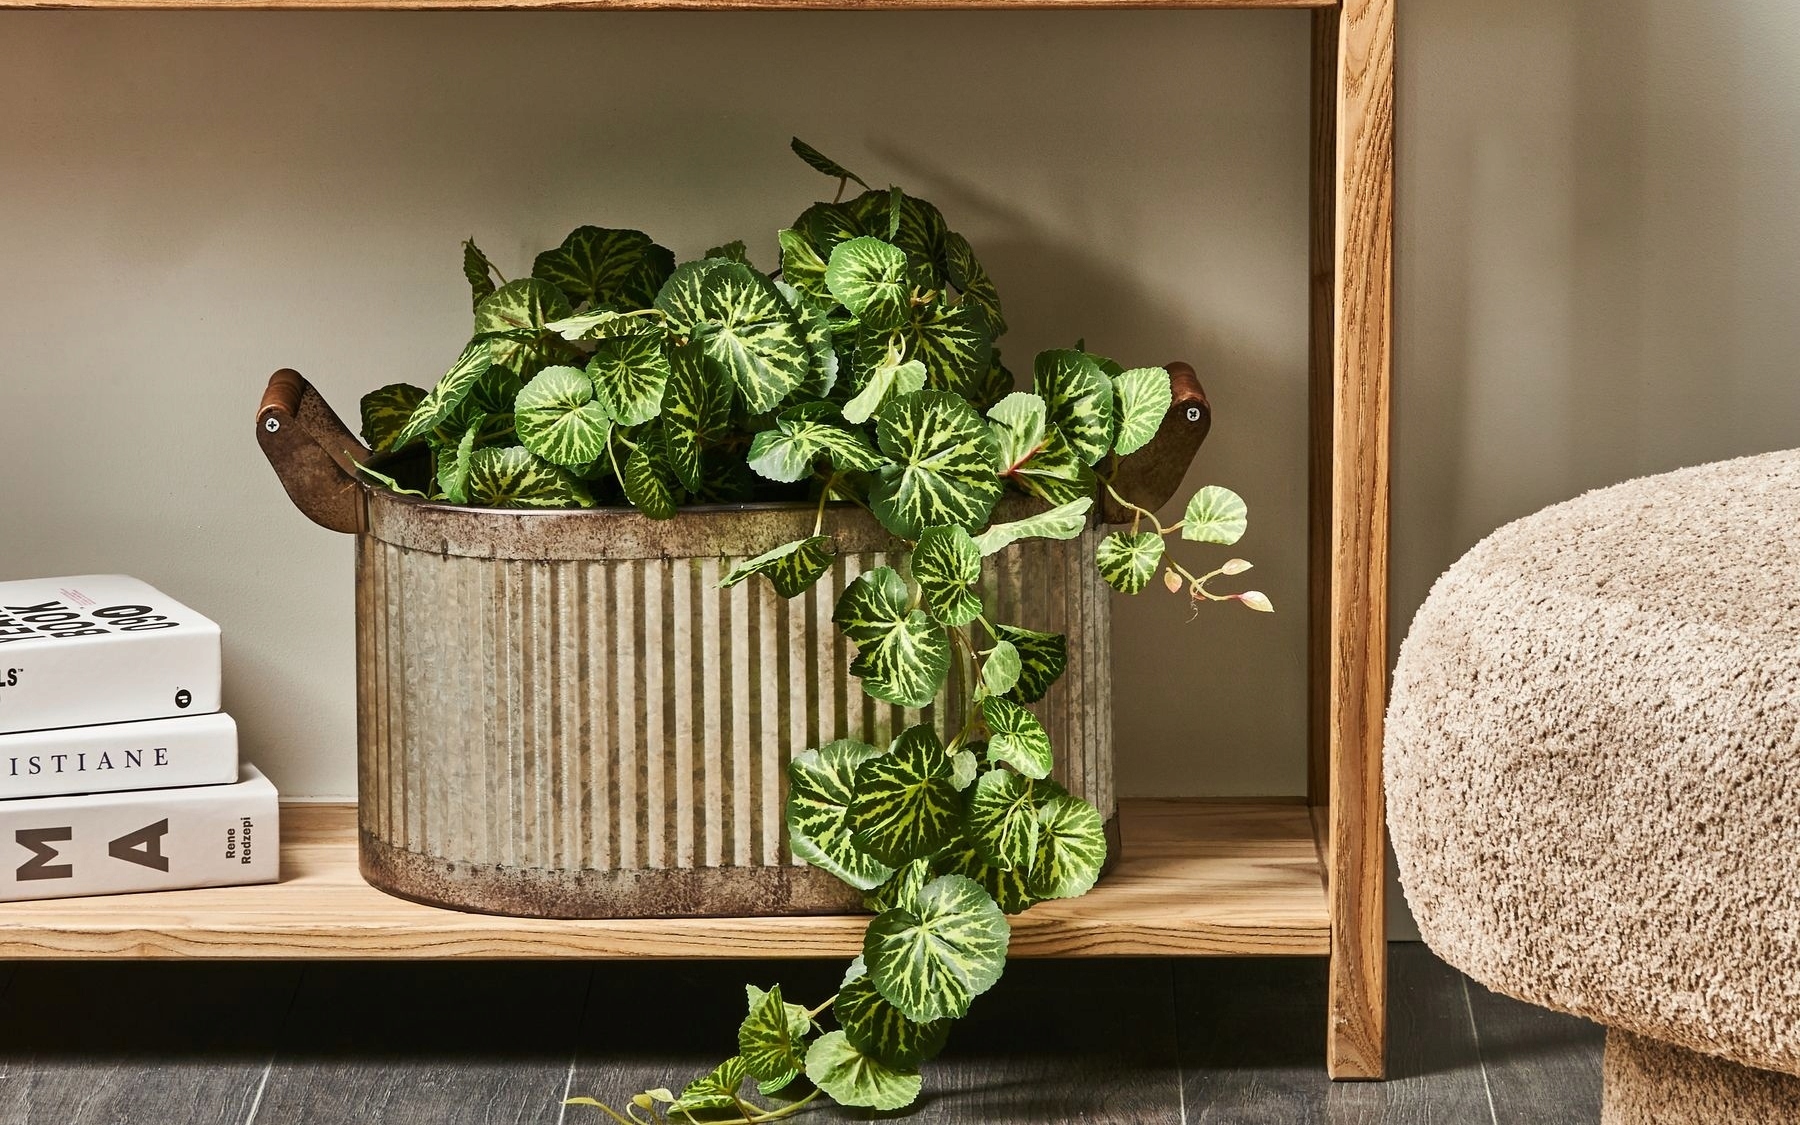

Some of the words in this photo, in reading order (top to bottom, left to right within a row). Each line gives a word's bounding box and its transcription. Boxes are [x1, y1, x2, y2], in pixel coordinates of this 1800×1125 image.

[4, 601, 112, 638] BOOK
[9, 748, 169, 776] ISTIANE
[225, 828, 236, 859] Rene
[240, 816, 254, 864] Redzepi
